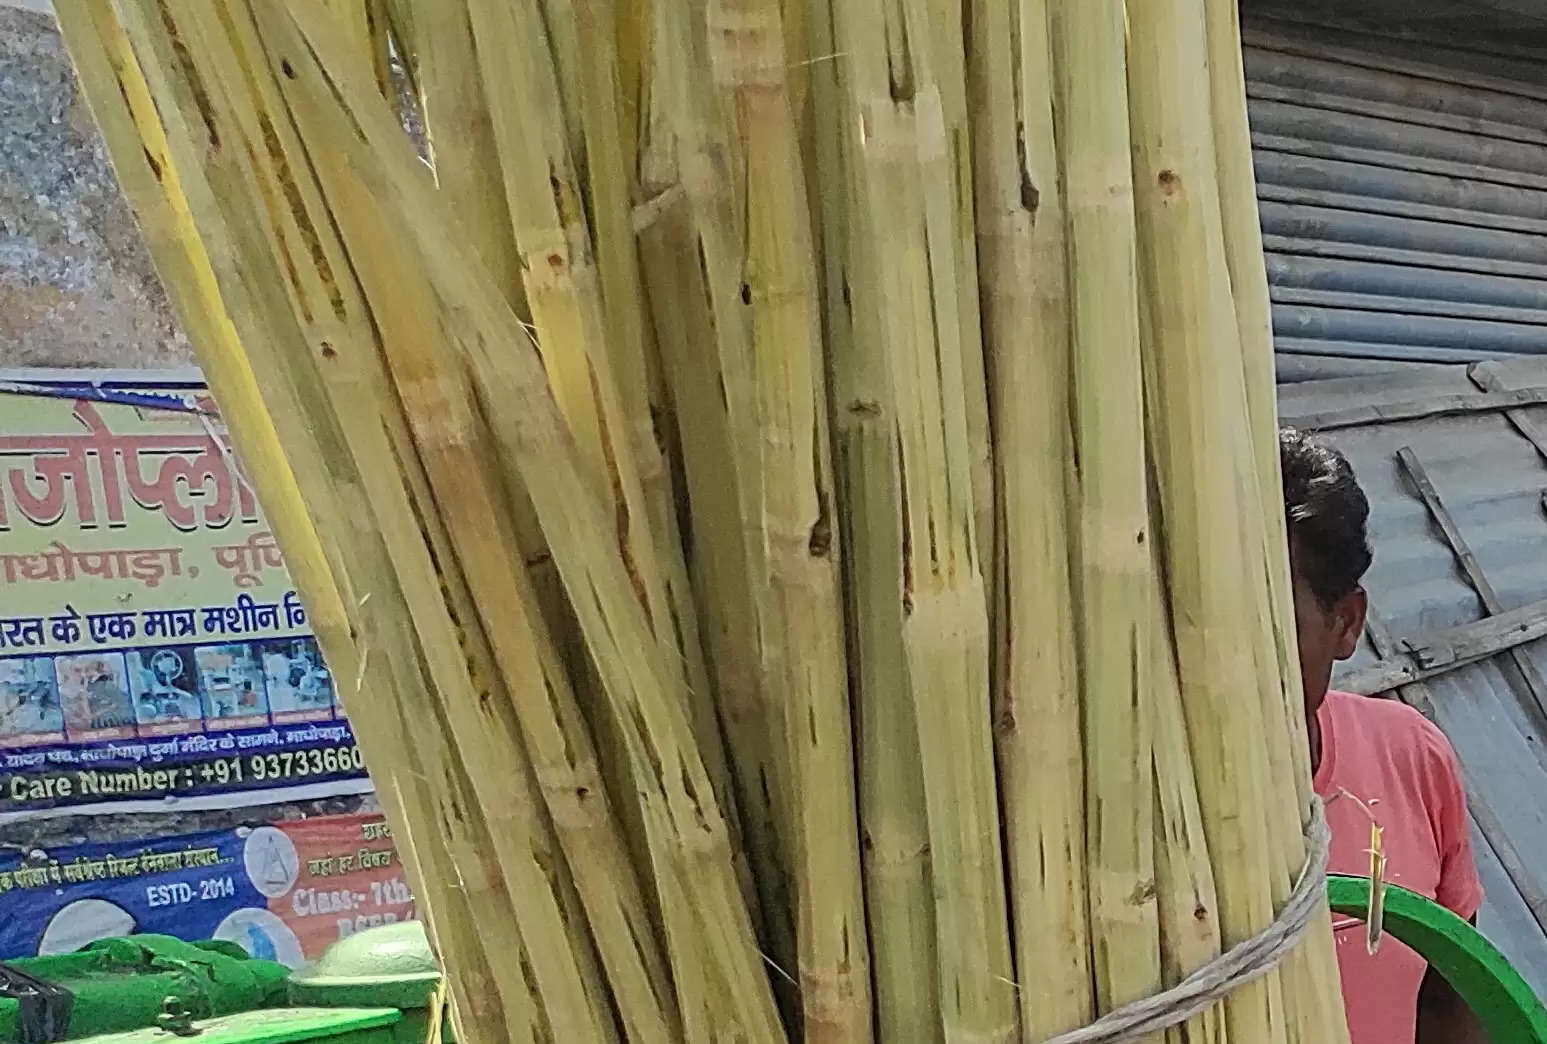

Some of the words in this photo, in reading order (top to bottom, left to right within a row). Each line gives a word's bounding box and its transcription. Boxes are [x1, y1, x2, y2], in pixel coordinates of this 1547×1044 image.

[0, 540, 199, 587] ाधोपाड़ा,
[49, 604, 81, 643] के
[86, 613, 137, 643] एक
[142, 609, 196, 637] मात्र
[201, 593, 279, 633] मशीन
[10, 776, 72, 800] Care
[79, 767, 178, 795] Number
[201, 757, 243, 784] +91
[200, 877, 235, 900] 2014
